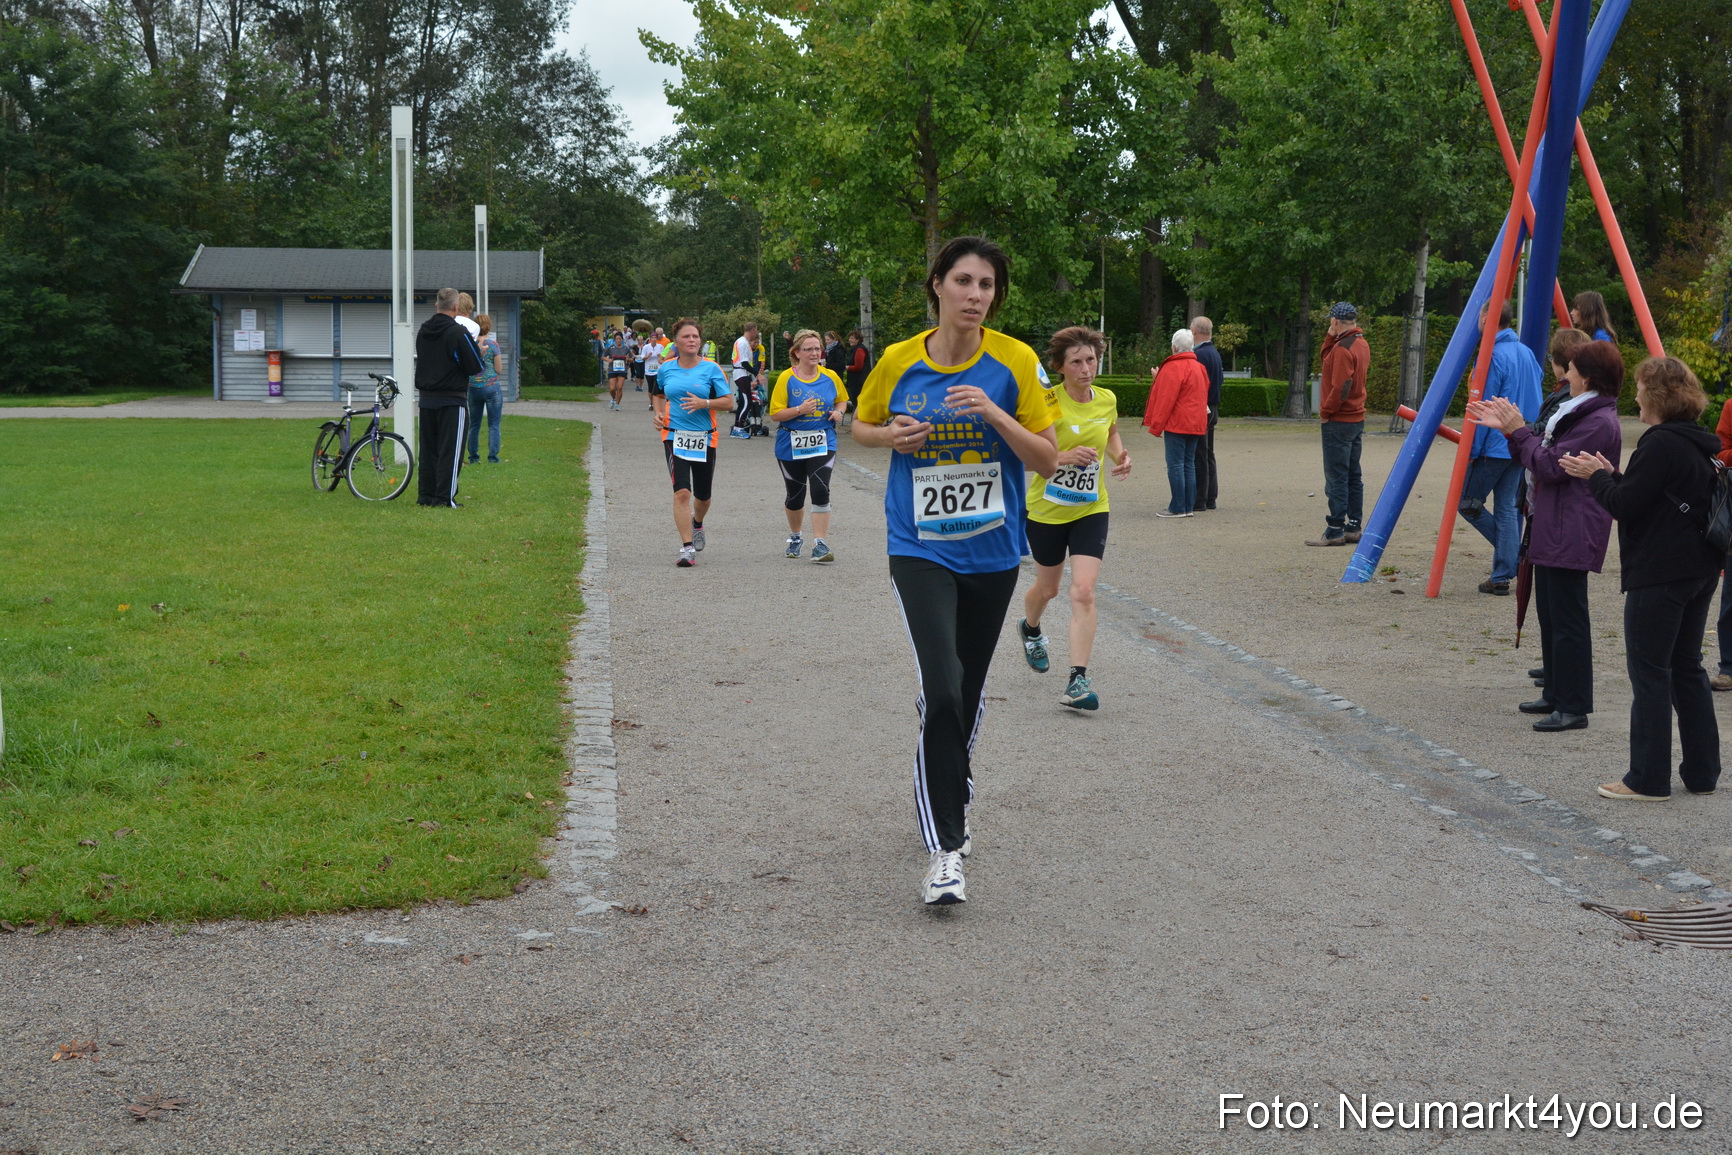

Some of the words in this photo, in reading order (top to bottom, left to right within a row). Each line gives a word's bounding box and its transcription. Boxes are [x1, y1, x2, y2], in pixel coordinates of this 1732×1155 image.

[676, 437, 705, 450] 3416
[795, 434, 823, 448] 2792
[914, 474, 942, 483] PARTL
[943, 470, 986, 481] Neumarkt
[1052, 468, 1095, 491] 2365
[922, 480, 993, 516] 2627
[1056, 489, 1087, 503] Gerlinde
[940, 519, 982, 533] Kathrin
